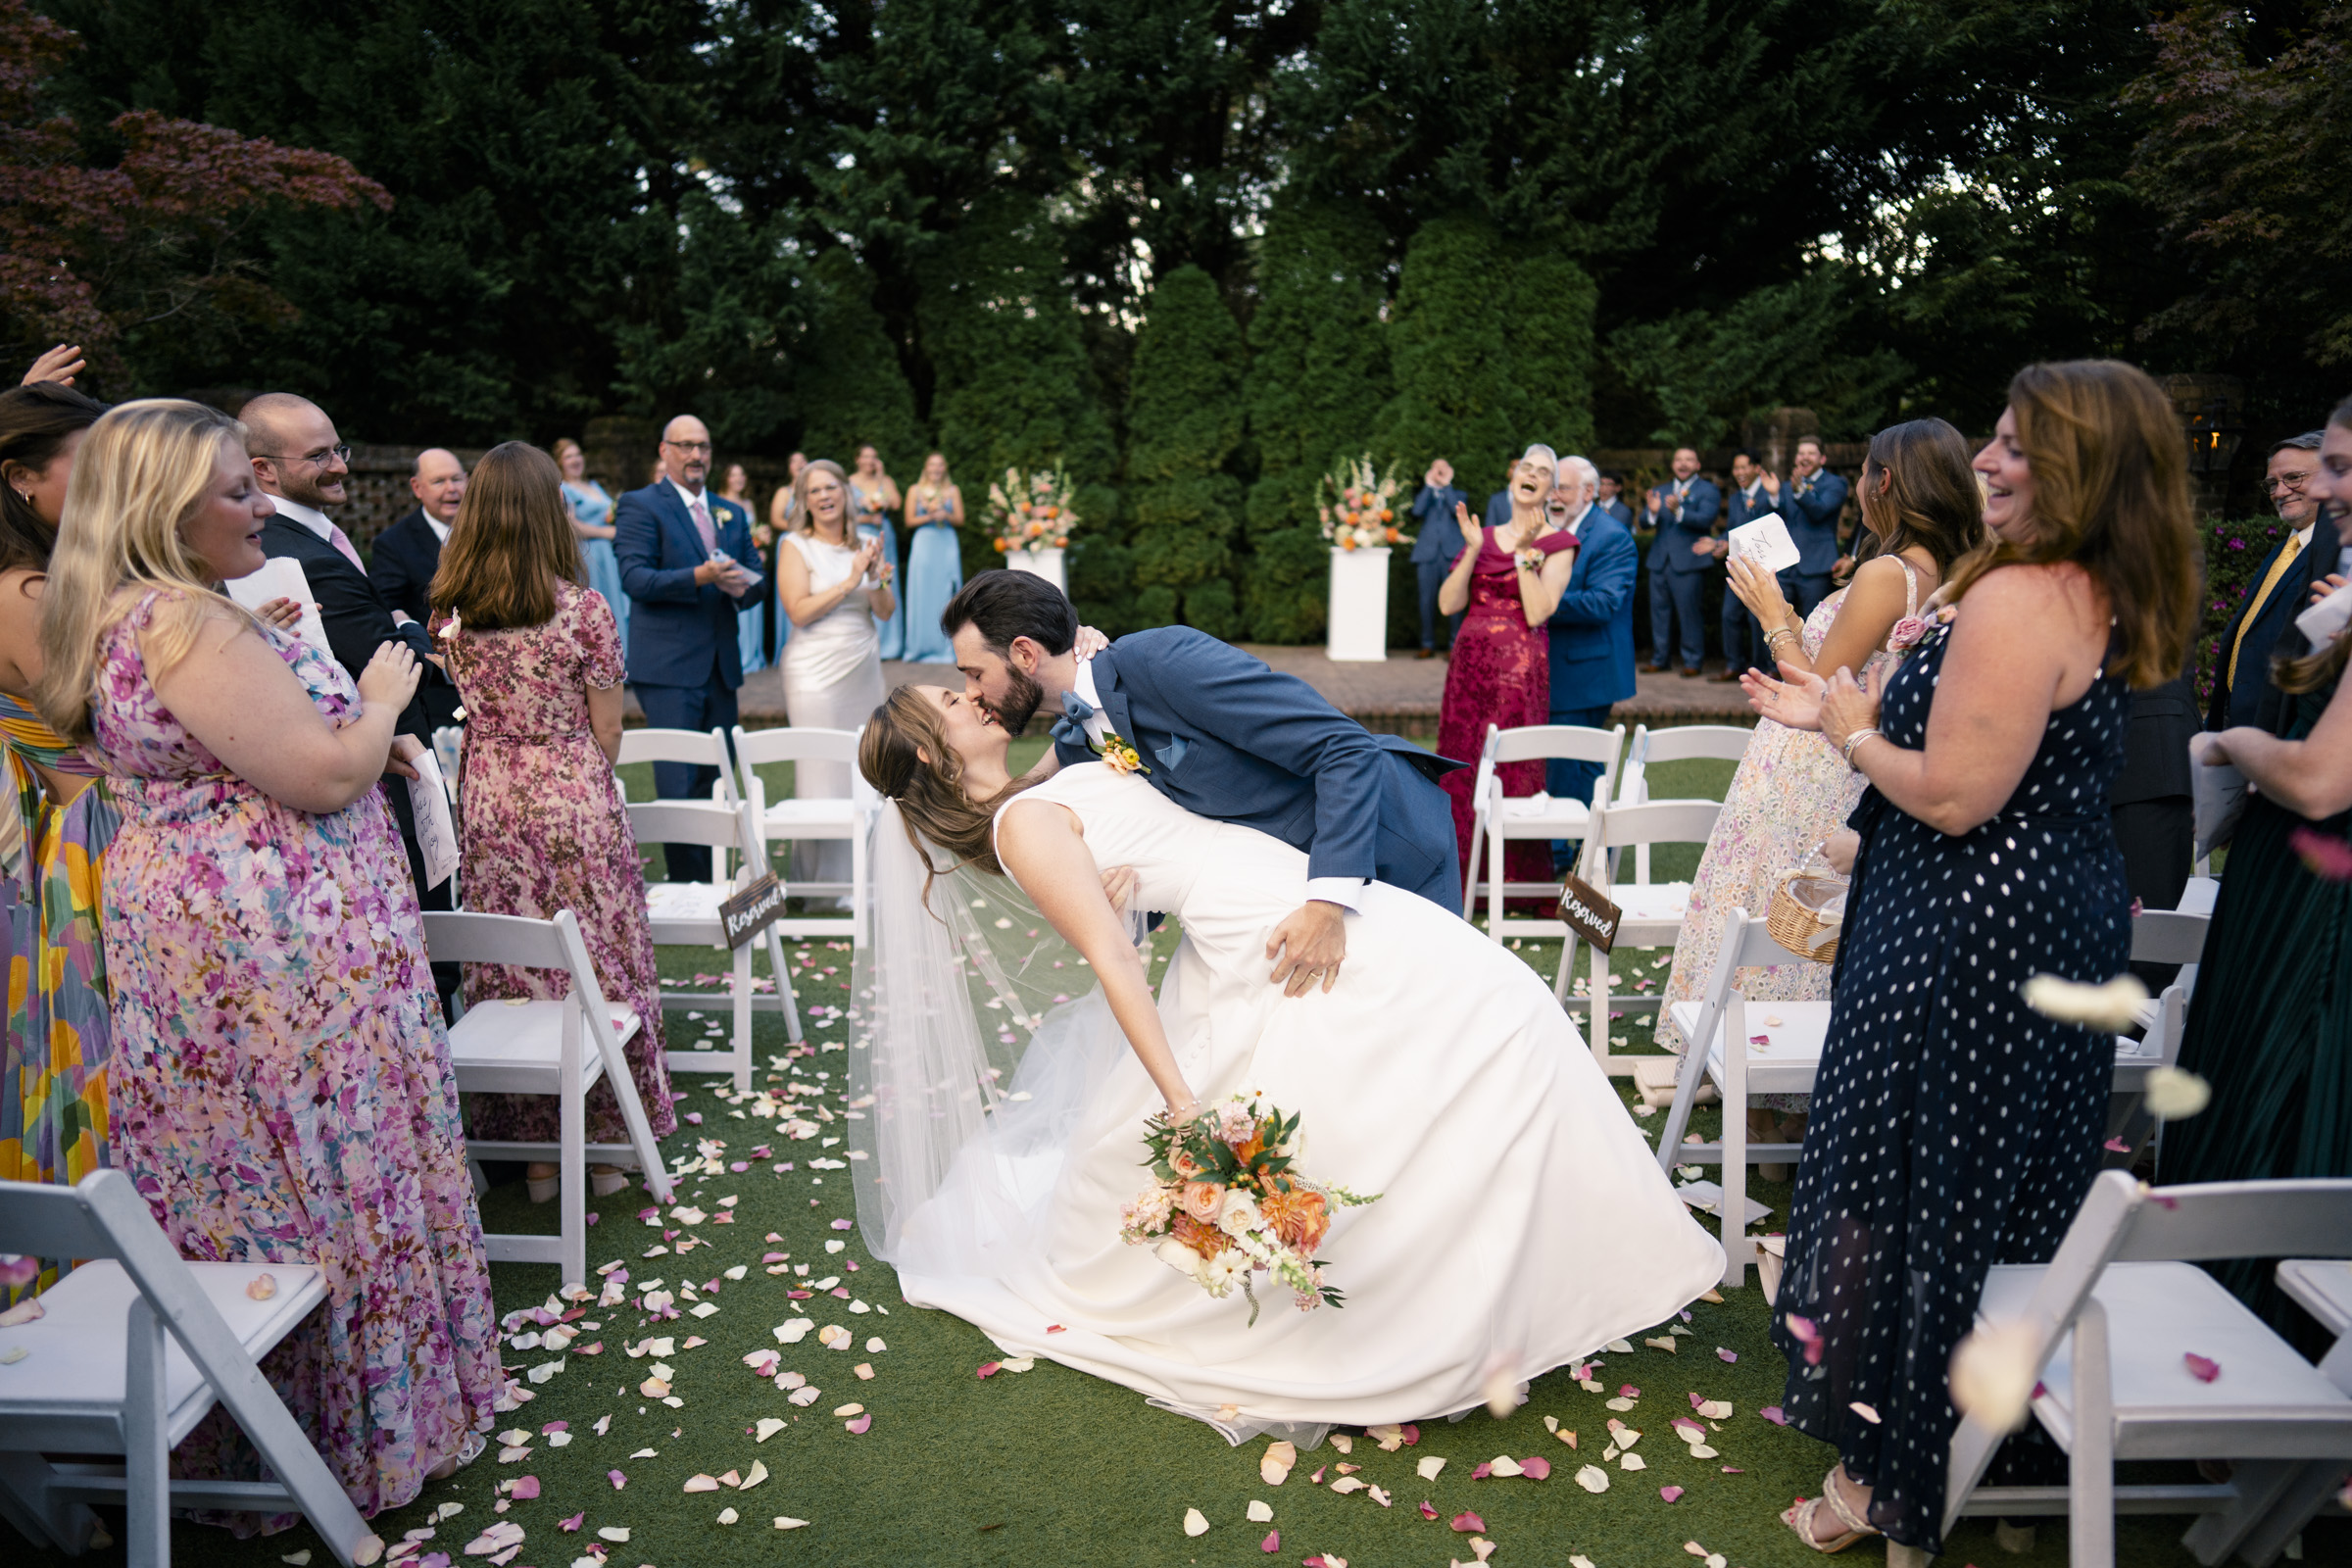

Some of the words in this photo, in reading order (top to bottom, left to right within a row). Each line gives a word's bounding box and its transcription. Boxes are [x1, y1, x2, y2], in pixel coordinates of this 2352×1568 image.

[1751, 530, 1772, 559] Toss
[420, 798, 434, 839] with
[427, 833, 439, 875] joy
[727, 886, 781, 937] Reserved
[1560, 886, 1613, 938] Reserved
